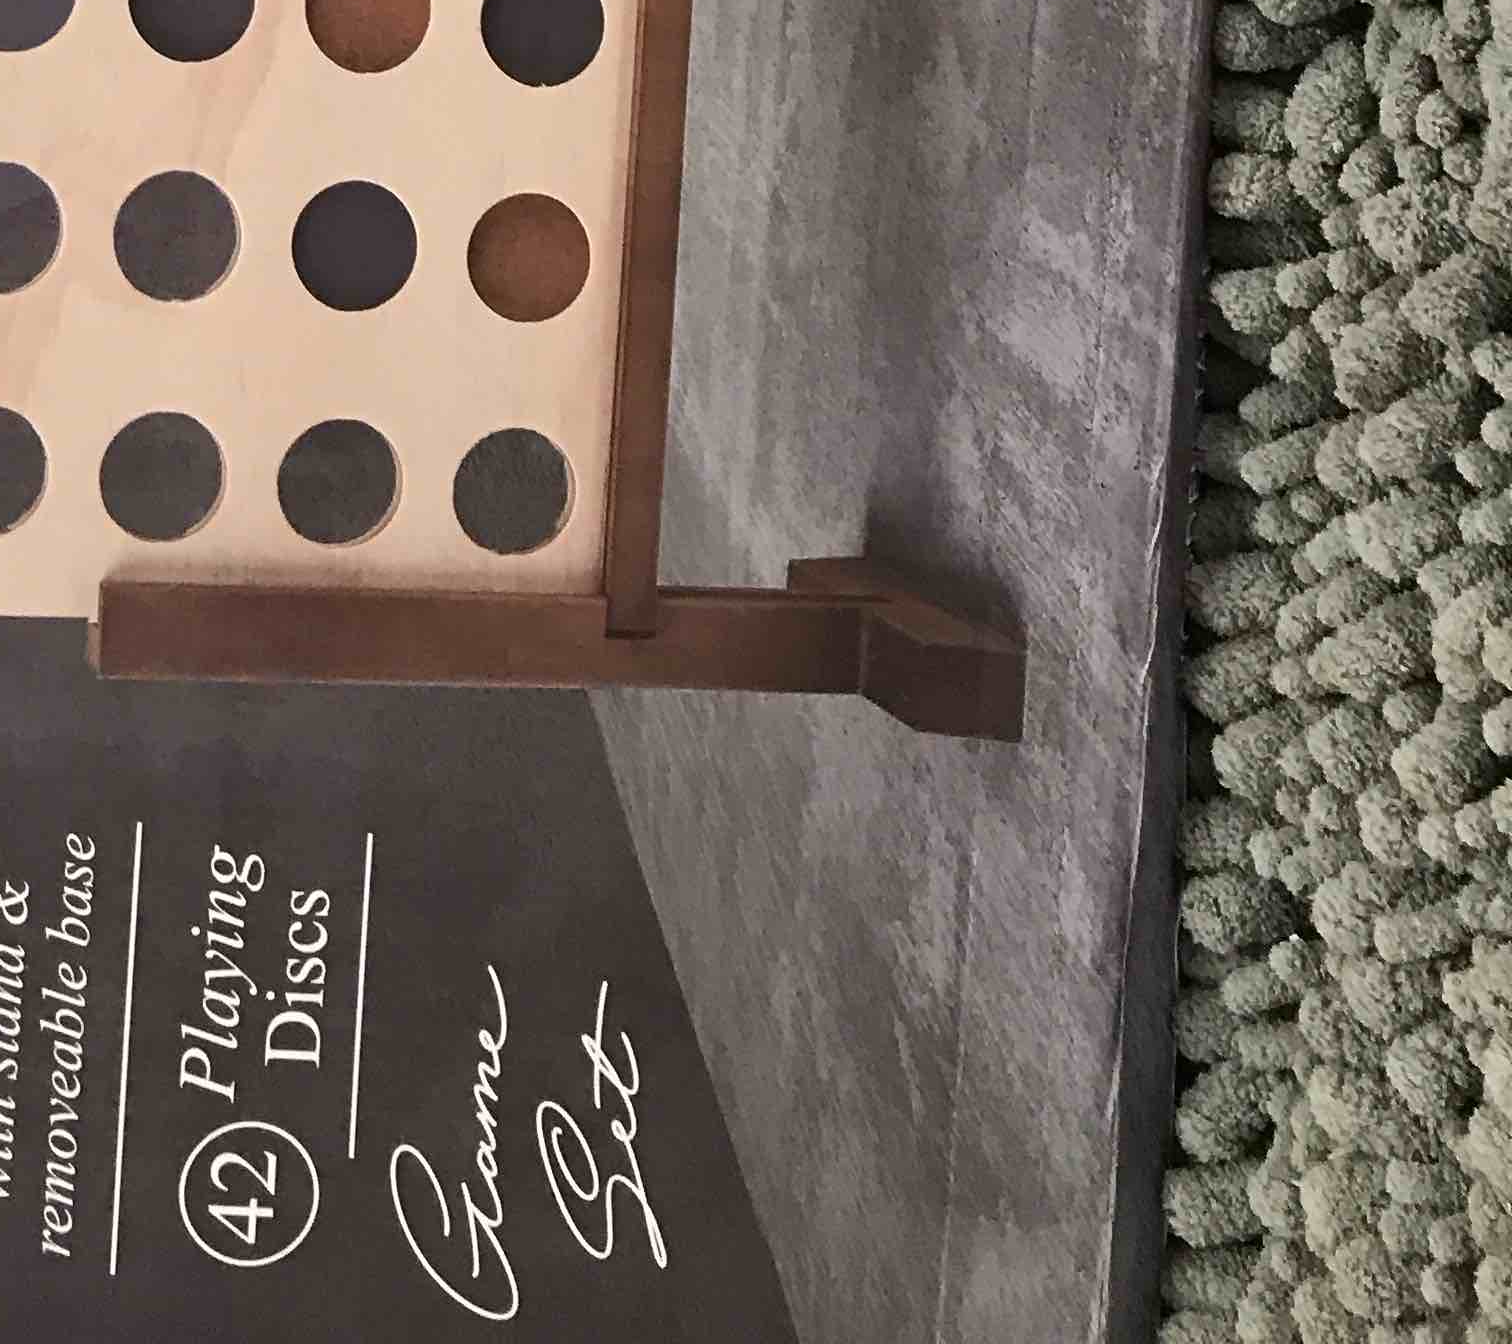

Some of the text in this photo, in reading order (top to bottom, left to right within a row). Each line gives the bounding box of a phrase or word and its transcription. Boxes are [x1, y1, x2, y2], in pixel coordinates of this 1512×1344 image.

[39, 831, 96, 1256] removeable base
[179, 844, 279, 1244] 42 Playing
[264, 886, 331, 1068] Discs
[389, 963, 519, 1320] Game
[536, 979, 668, 1268] Set
